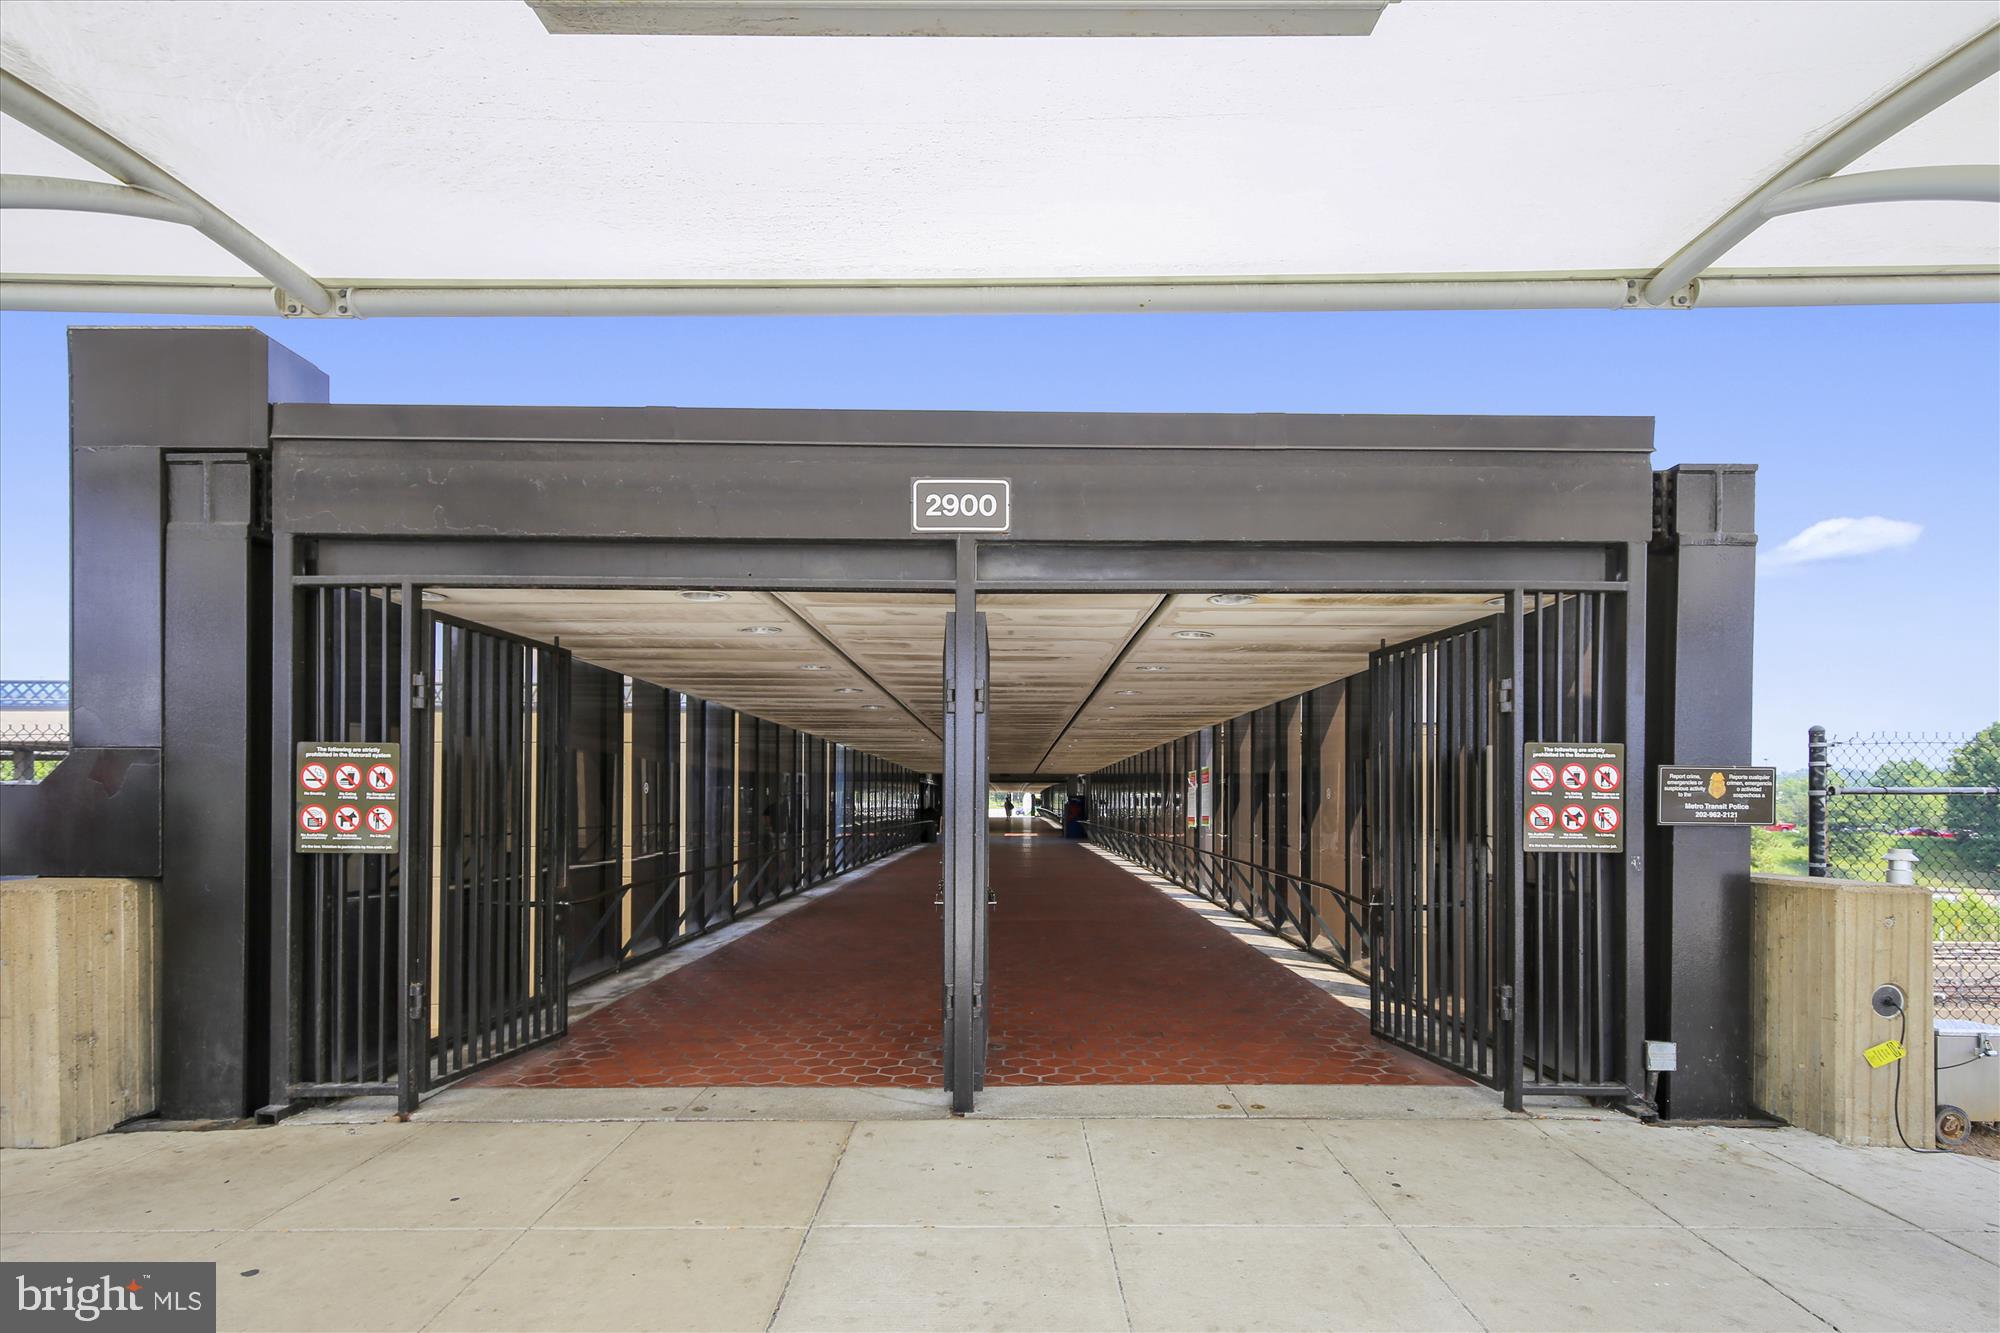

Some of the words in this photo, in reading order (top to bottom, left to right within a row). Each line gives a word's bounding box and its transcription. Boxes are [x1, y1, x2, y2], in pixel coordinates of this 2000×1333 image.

[926, 494, 997, 516] 2900
[328, 746, 352, 754] following
[1554, 746, 1578, 754] following
